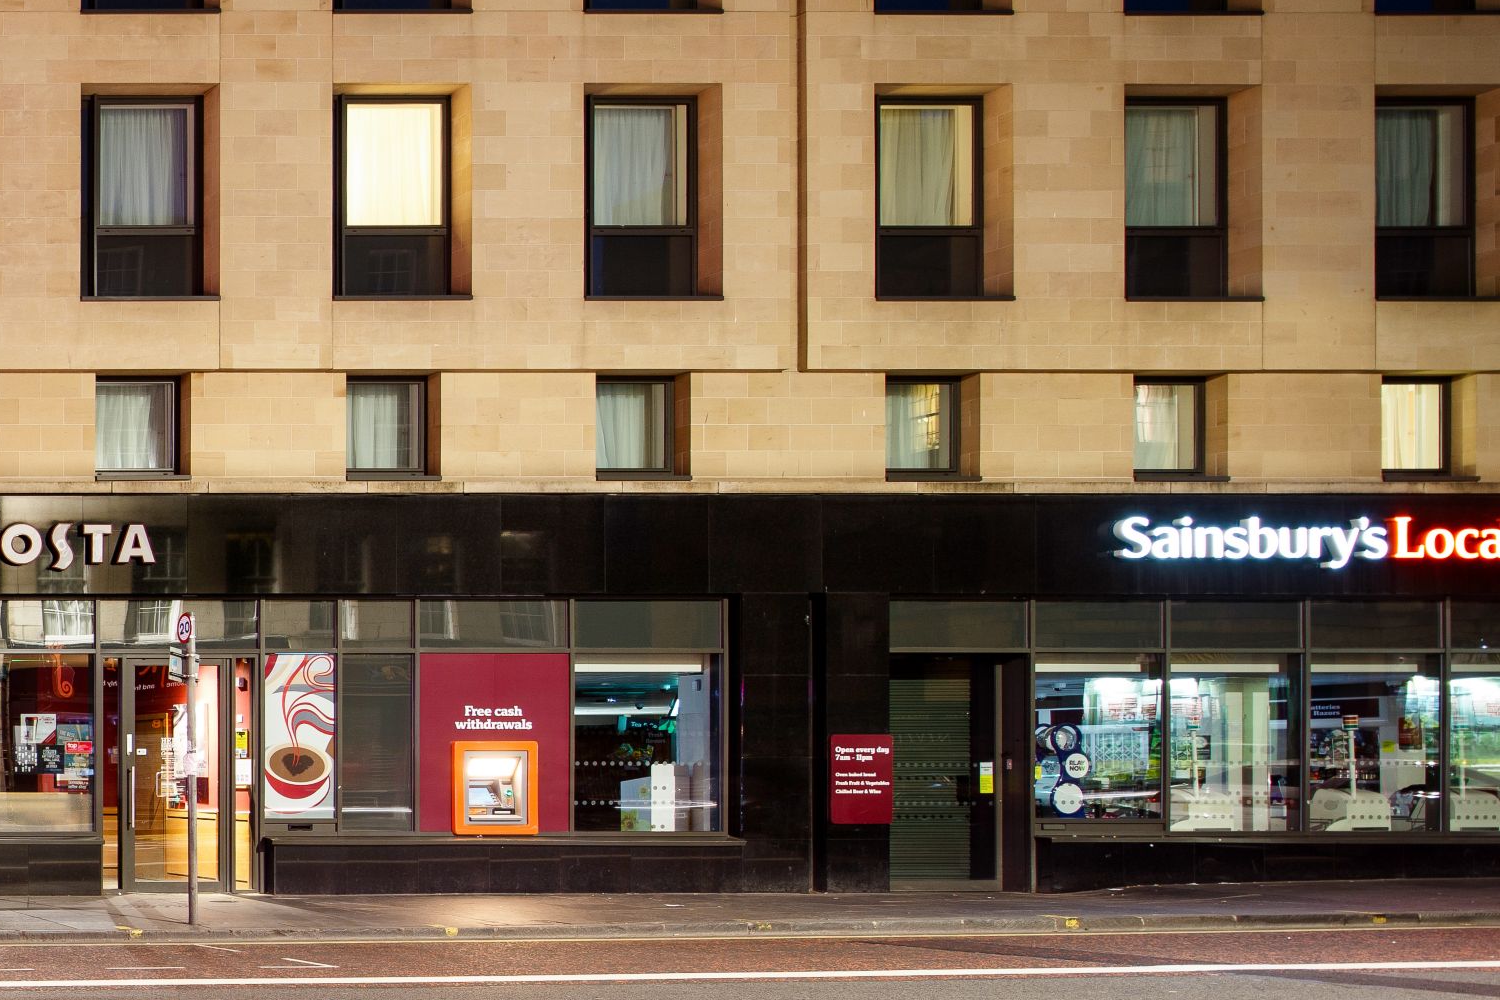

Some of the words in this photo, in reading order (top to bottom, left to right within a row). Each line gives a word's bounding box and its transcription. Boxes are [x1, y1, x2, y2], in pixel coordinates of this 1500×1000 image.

[1114, 515, 1388, 569] Sainsbury's
[1393, 515, 1500, 559] Loca
[179, 621, 190, 635] 20
[464, 705, 492, 717] Free
[494, 705, 523, 717] cash
[455, 719, 532, 730] withdrawals
[835, 746, 855, 754] Open
[876, 746, 890, 754] day
